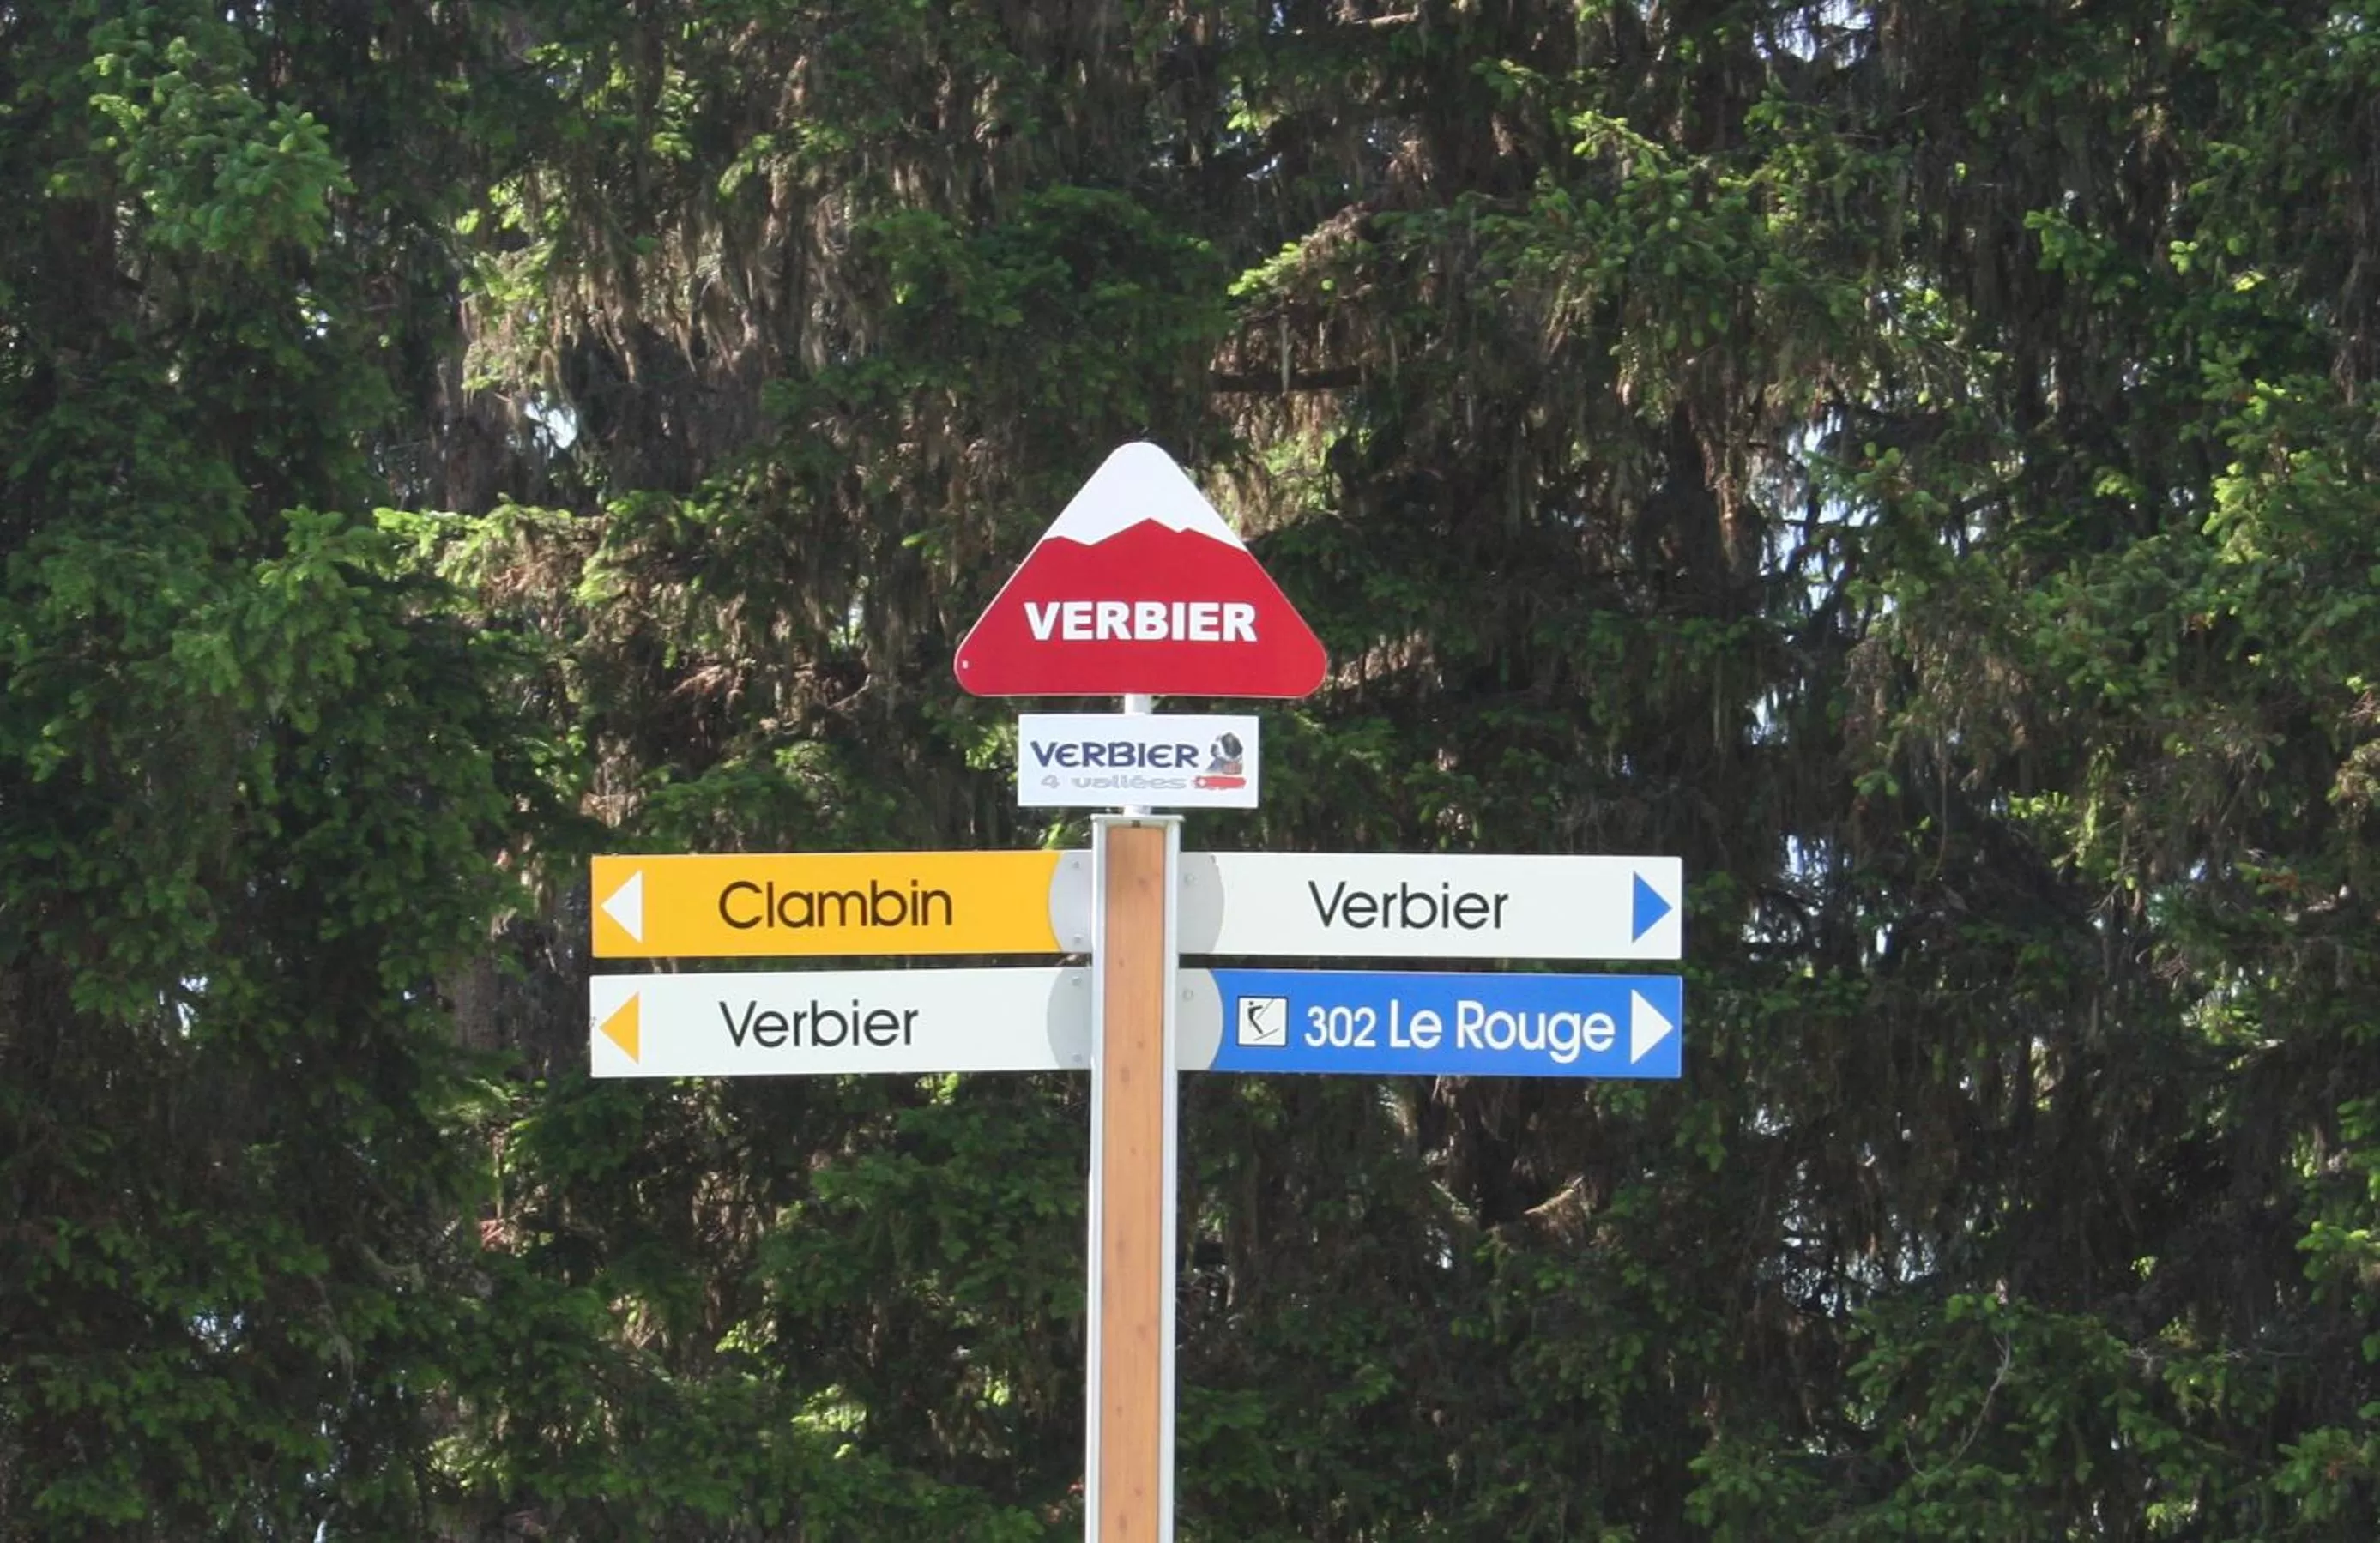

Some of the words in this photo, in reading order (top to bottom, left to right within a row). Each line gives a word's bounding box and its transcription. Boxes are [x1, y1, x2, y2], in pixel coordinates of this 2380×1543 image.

[1024, 601, 1258, 642] VERBIER
[1030, 740, 1199, 768] VERBIER
[1040, 775, 1060, 789] 4
[718, 879, 953, 929] Clambin
[1308, 880, 1509, 930] Verbier
[719, 998, 919, 1048] Verbier
[1303, 1006, 1377, 1049] 302
[1389, 998, 1443, 1049] Le
[1457, 999, 1616, 1064] Rouge
